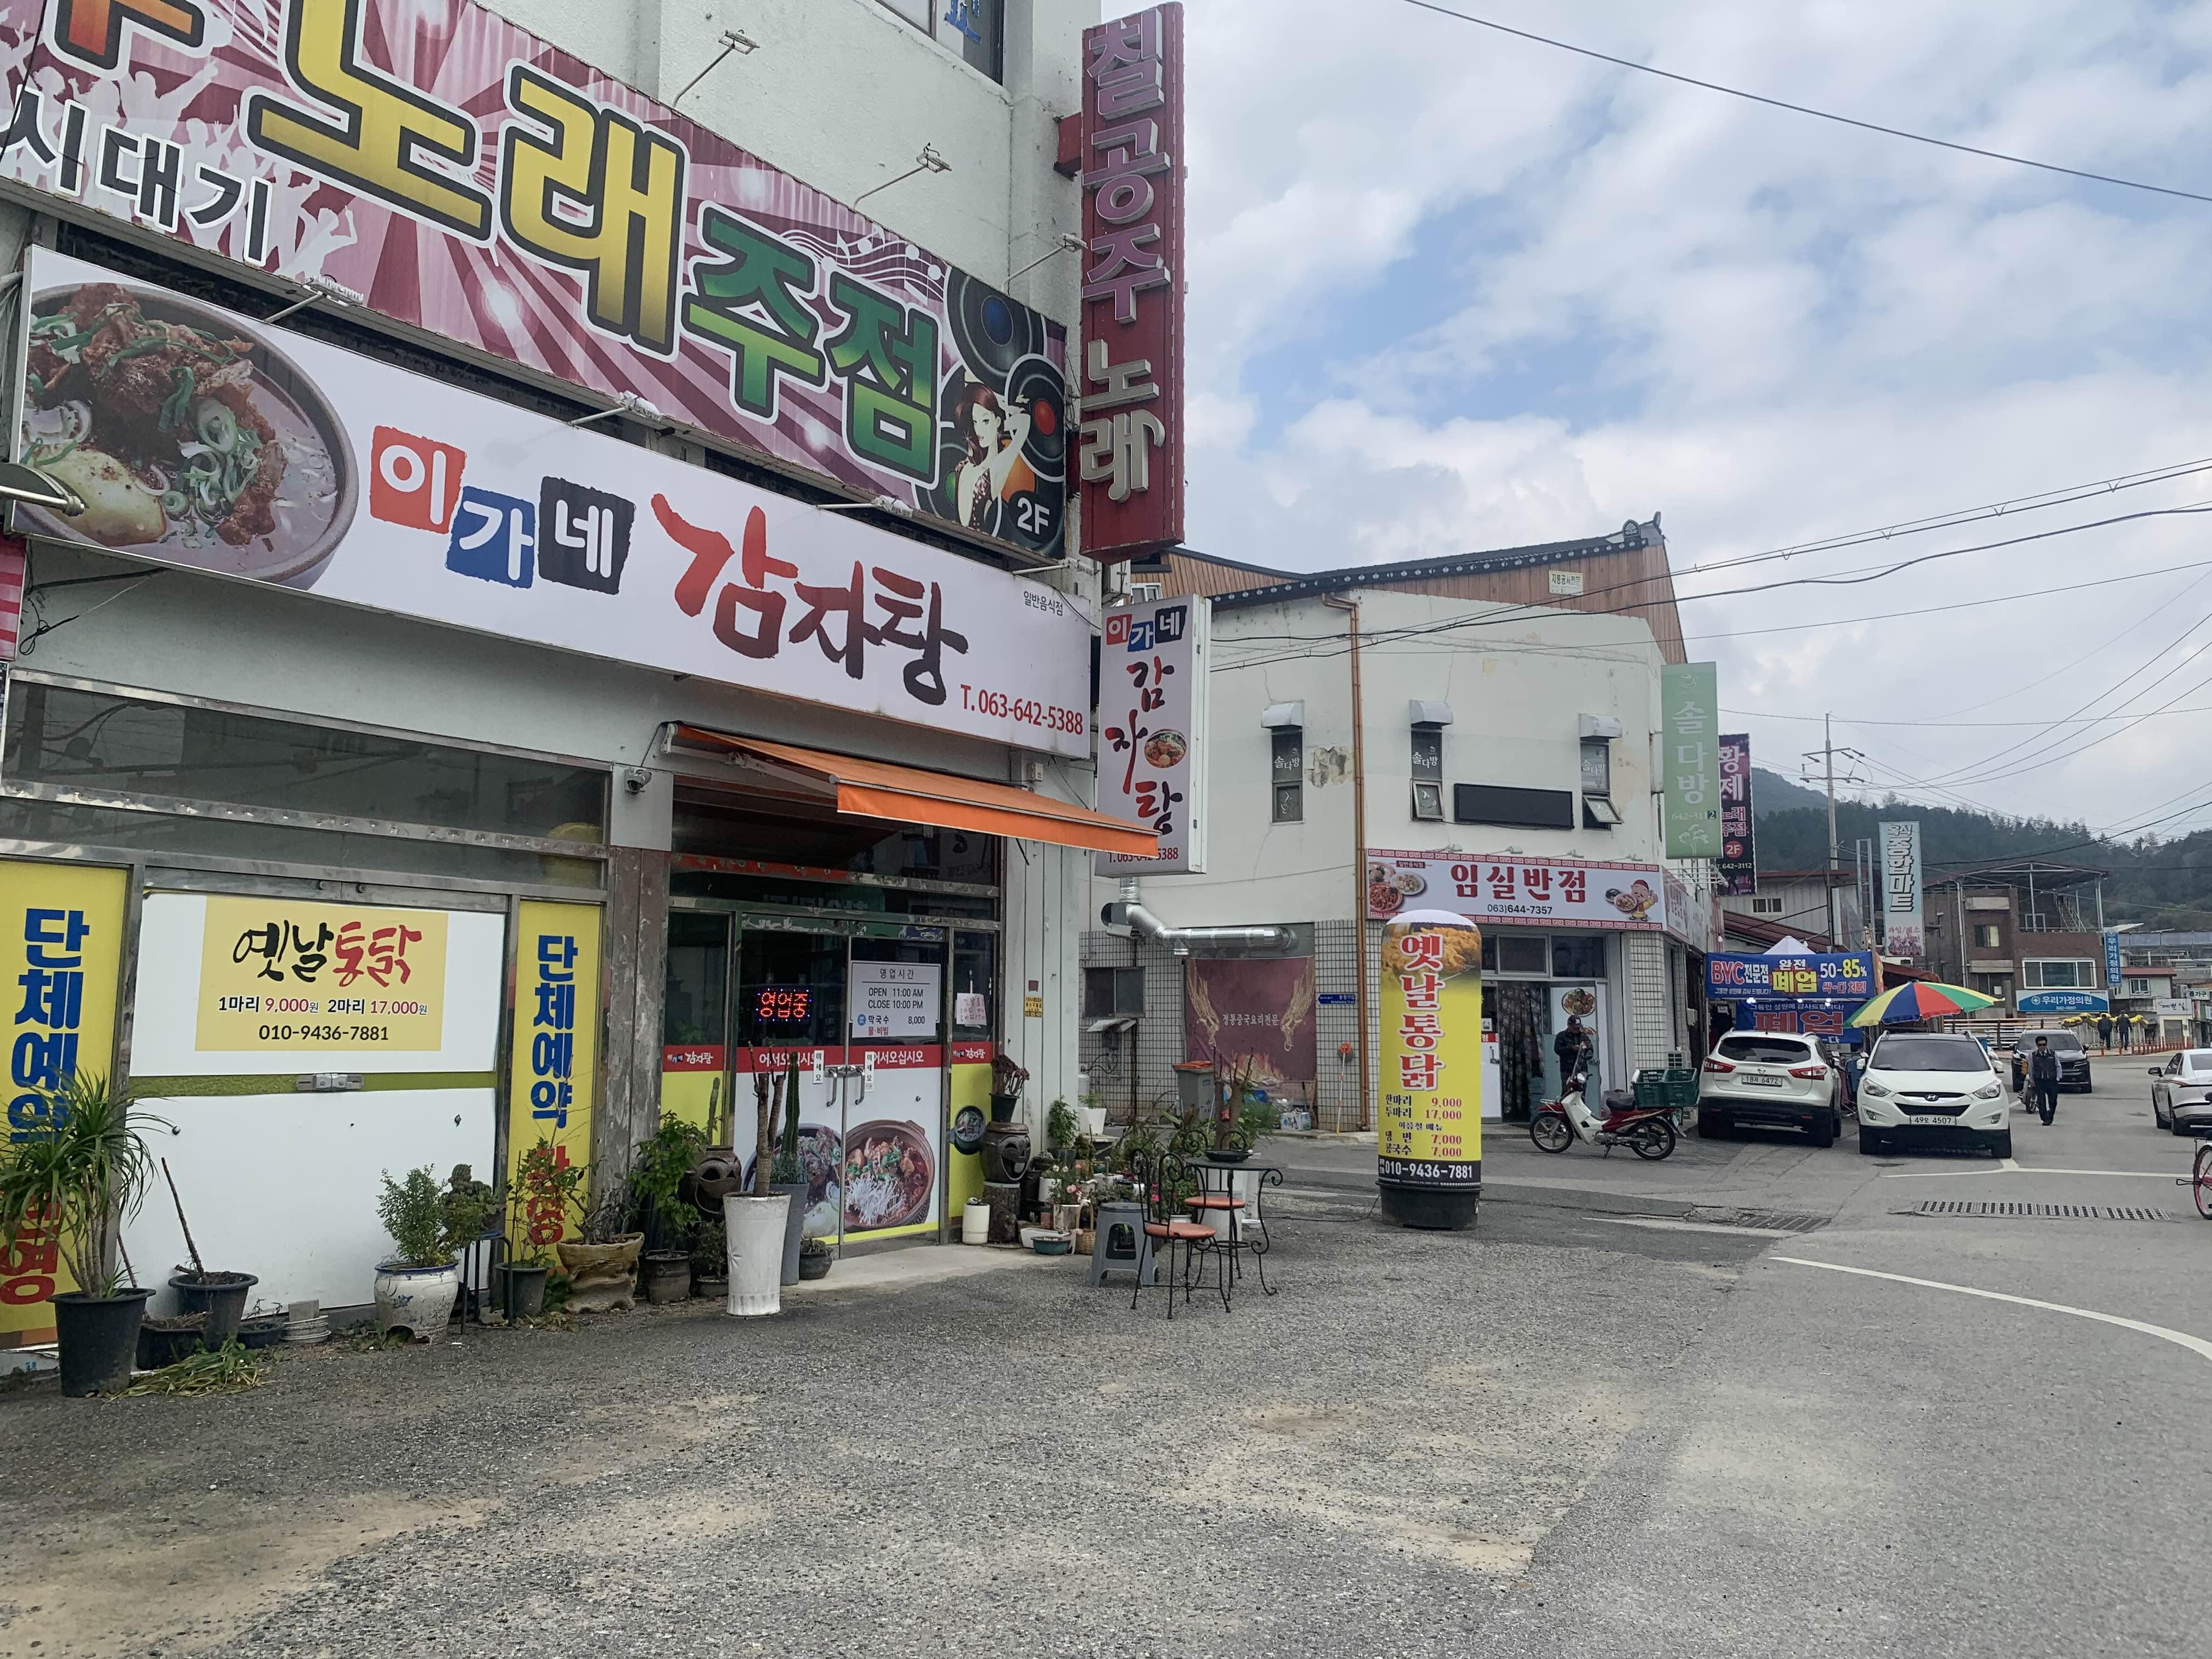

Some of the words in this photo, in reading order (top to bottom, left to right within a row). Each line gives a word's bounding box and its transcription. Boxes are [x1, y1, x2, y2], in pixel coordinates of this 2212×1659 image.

[1080, 338, 1166, 503] 노래
[377, 442, 616, 583] 이가네
[1017, 497, 1050, 535] 2F
[651, 493, 969, 706] 감자탕
[1023, 590, 1063, 617] 일반음식점
[1107, 610, 1181, 650] 이가네
[1104, 656, 1183, 836] 감자탕
[1672, 701, 1710, 804] 솔다방
[1412, 751, 1438, 769] 솔다방
[1726, 845, 1740, 855] 2F
[1450, 864, 1587, 903] 임실반점
[1887, 836, 1915, 912] 종합마트
[1487, 904, 1553, 915] 063)644-7357
[1779, 959, 1806, 970] 완전
[2107, 937, 2119, 983] 우리가정의원
[868, 988, 887, 997] OPEN
[893, 988, 911, 997] 11:00
[912, 989, 923, 997] AM
[1771, 970, 1818, 994] 폐업
[218, 995, 259, 1013] 1마리
[265, 997, 319, 1014] 9,000원
[328, 998, 365, 1014] 2마리
[370, 1000, 427, 1016] 17,000원
[760, 991, 809, 1018] 영업중
[868, 1000, 890, 1009] CLOSE
[893, 1000, 911, 1009] 10:00
[912, 1001, 923, 1009] PM
[2042, 996, 2092, 1005] 우리가정의원
[868, 1015, 889, 1024] 막국수
[908, 1016, 926, 1025] 8,000
[1398, 933, 1445, 1091] 옛날통닭
[258, 1024, 388, 1041] 010-9436-7881
[530, 934, 579, 1130] 단체예약
[1753, 1011, 1844, 1036] 폐업
[685, 1050, 714, 1064] 감자탕
[1385, 1094, 1412, 1106] 한마리
[1431, 1097, 1462, 1108] 9,000
[1385, 1107, 1412, 1118] 두마리
[1425, 1109, 1462, 1120] 17,000
[1385, 1143, 1412, 1155] 콩국수
[1431, 1147, 1462, 1158] 7,000
[1431, 1134, 1462, 1145] 7,000
[1385, 1160, 1473, 1179] 010-9436-7881
